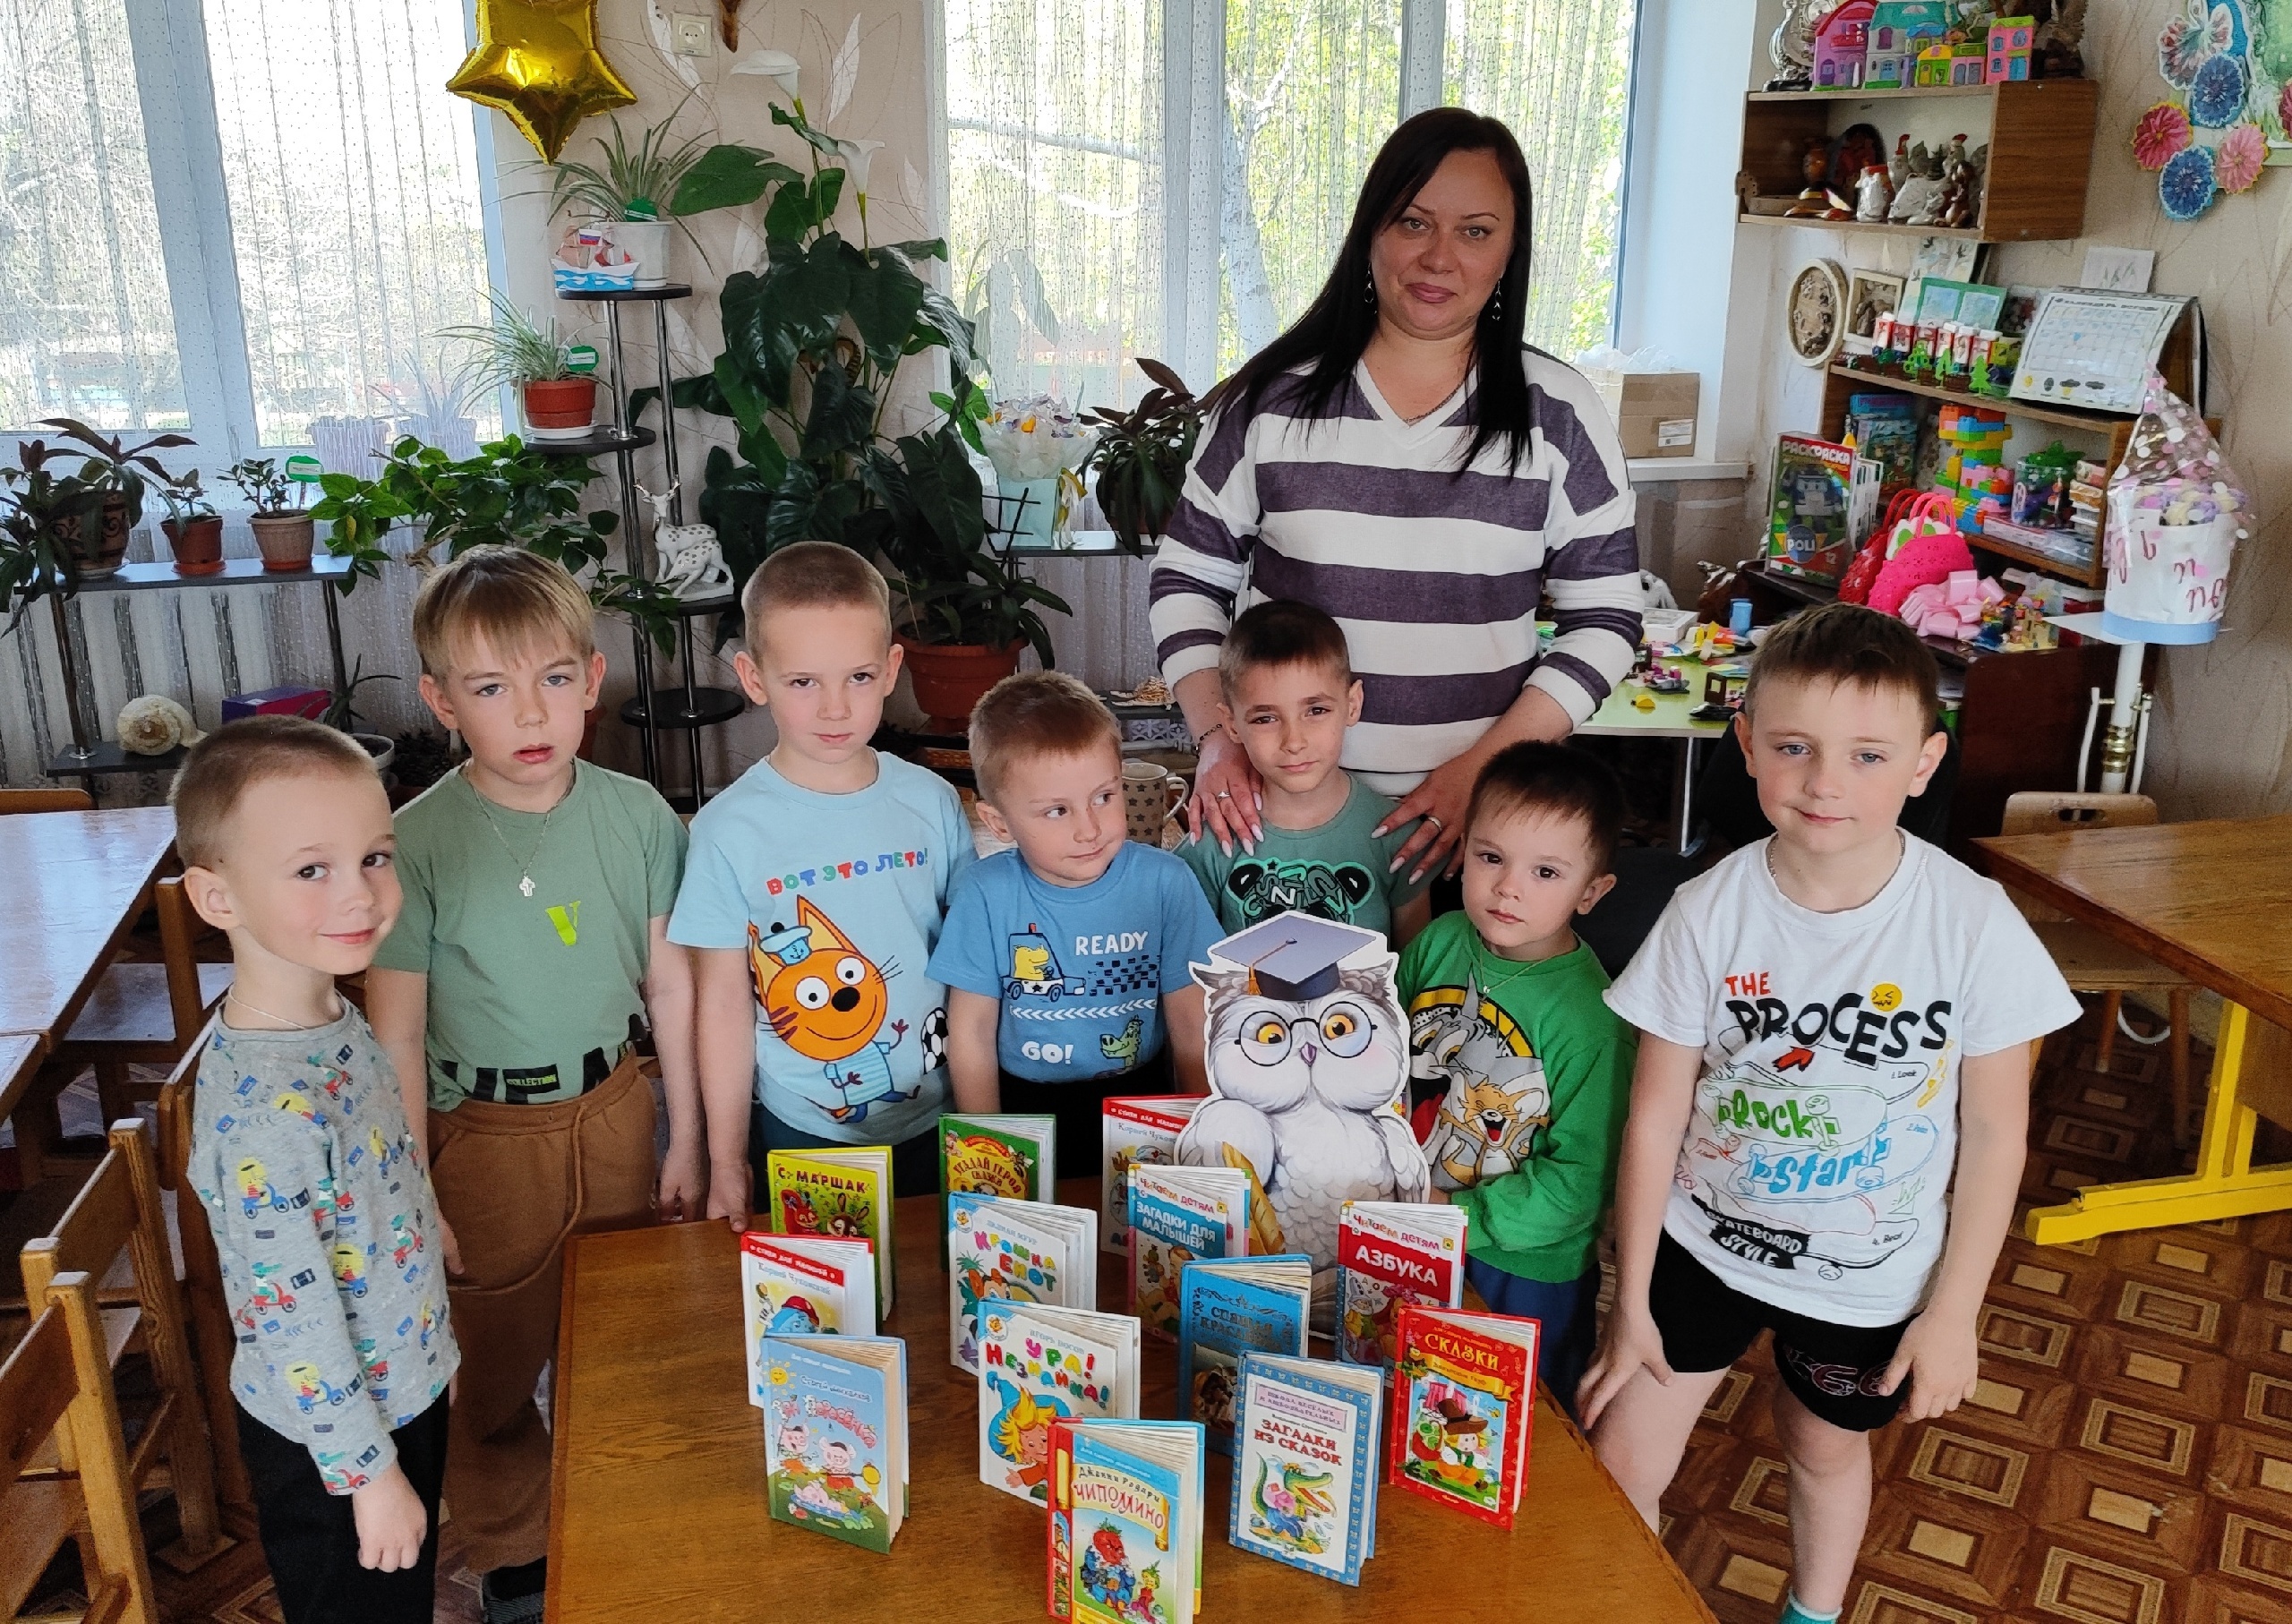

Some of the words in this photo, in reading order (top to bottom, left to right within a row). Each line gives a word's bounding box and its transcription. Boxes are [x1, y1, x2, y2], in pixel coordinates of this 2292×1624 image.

[766, 868, 817, 895] ВОТ
[823, 860, 868, 881] ЭТО
[875, 847, 928, 873] ЛЕТО!
[1075, 930, 1149, 957] READY
[1724, 971, 1772, 996] THE
[1725, 992, 1952, 1066] PROCESS
[1021, 1040, 1074, 1064] GO!
[796, 1169, 866, 1194] МАРШАК
[953, 1156, 990, 1176] УГАДАЙ
[992, 1163, 1022, 1194] ГЕРОЯ
[1140, 1177, 1178, 1202] Читаем
[1136, 1201, 1187, 1231] ЗАГАДКИ
[1189, 1223, 1216, 1243] ДЛЯ
[1142, 1216, 1205, 1252] МАЛЫШЕЙ
[1353, 1213, 1398, 1240] Читаем
[1400, 1232, 1441, 1252] детям
[973, 1229, 1057, 1271] КРОШКА
[1355, 1244, 1439, 1287] АЗБУКА
[1719, 1234, 1780, 1266] STYLE
[998, 1252, 1057, 1292] ЕНОТ
[1025, 1337, 1096, 1380] УРА!
[1424, 1333, 1500, 1372] СКАЗКИ
[1253, 1428, 1275, 1444] ИЗ
[1278, 1437, 1343, 1466] СКАЗОК
[1261, 1418, 1338, 1452] ЗАГАДКИ
[1078, 1466, 1119, 1483] Джанни
[1122, 1476, 1160, 1503] Родари
[1073, 1483, 1164, 1529] ЧИПОЛЛИНО
